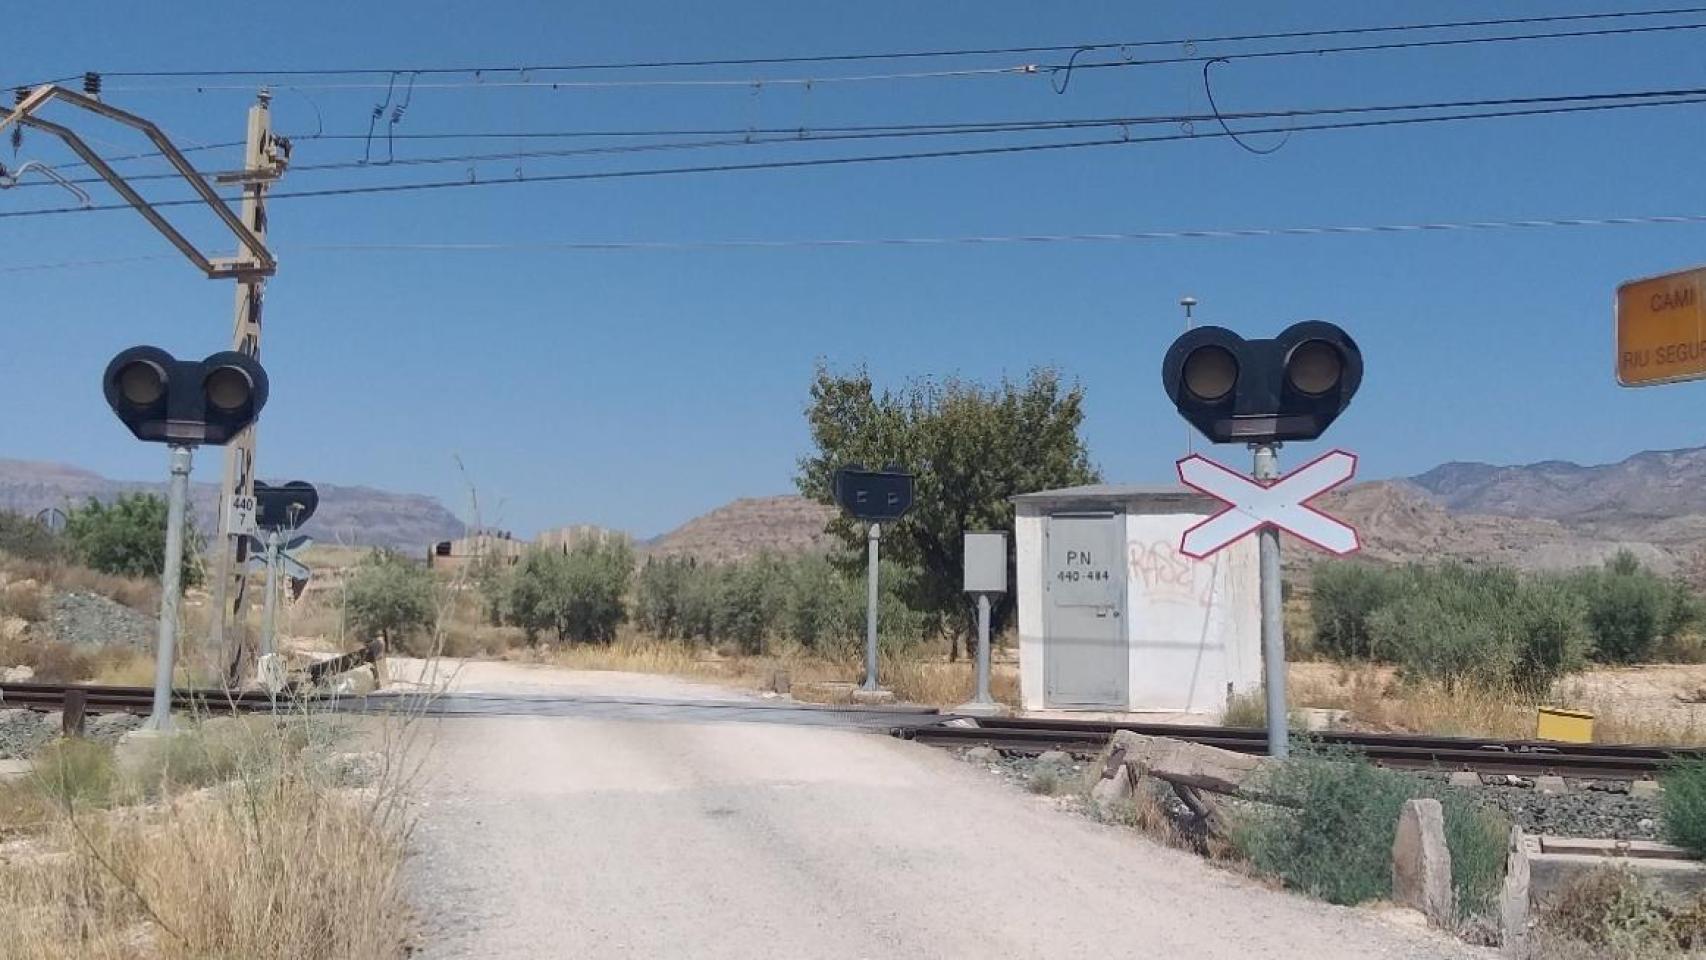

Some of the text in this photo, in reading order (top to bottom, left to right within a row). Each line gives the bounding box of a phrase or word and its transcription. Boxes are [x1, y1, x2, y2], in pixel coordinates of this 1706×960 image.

[1650, 287, 1694, 312] CAMI
[1623, 349, 1650, 368] RIU
[232, 497, 254, 511] 440
[239, 513, 246, 527] 7
